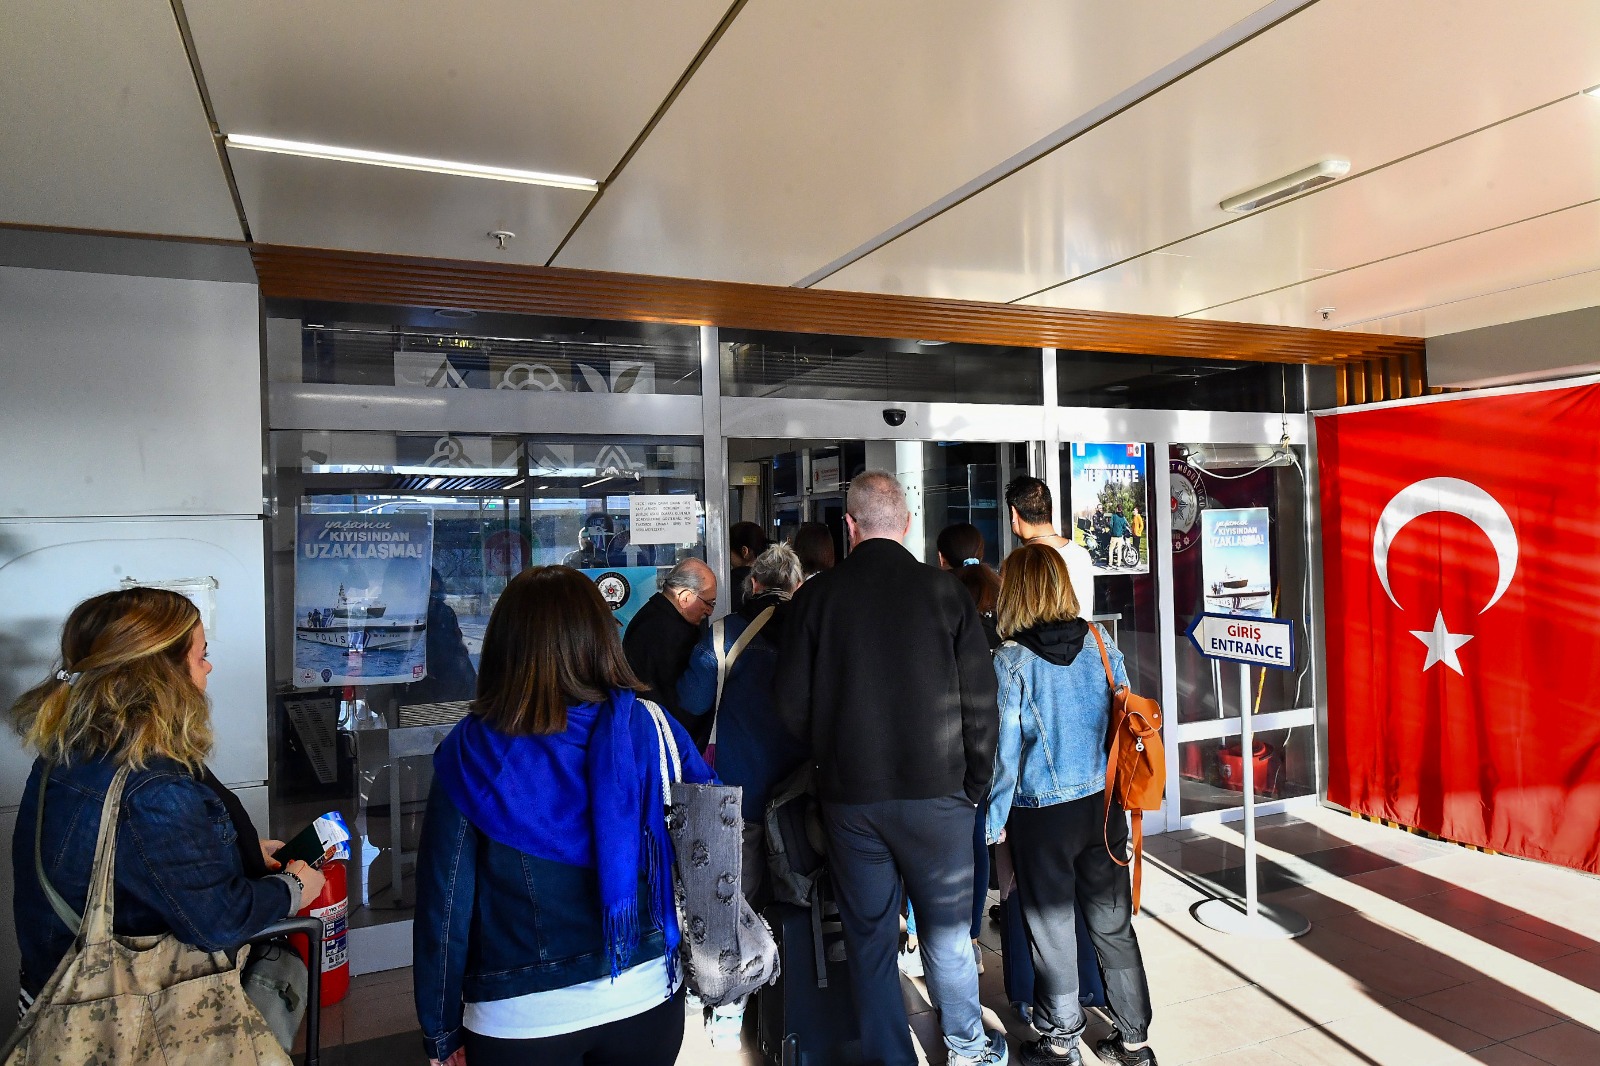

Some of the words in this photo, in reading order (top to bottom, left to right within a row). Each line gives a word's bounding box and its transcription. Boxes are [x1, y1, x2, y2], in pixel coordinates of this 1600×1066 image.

[329, 531, 410, 541] KIYISINDAN
[305, 543, 423, 559] UZAKLAŞMA!
[1227, 623, 1261, 642] GİRİŞ
[1211, 637, 1283, 659] ENTRANCE
